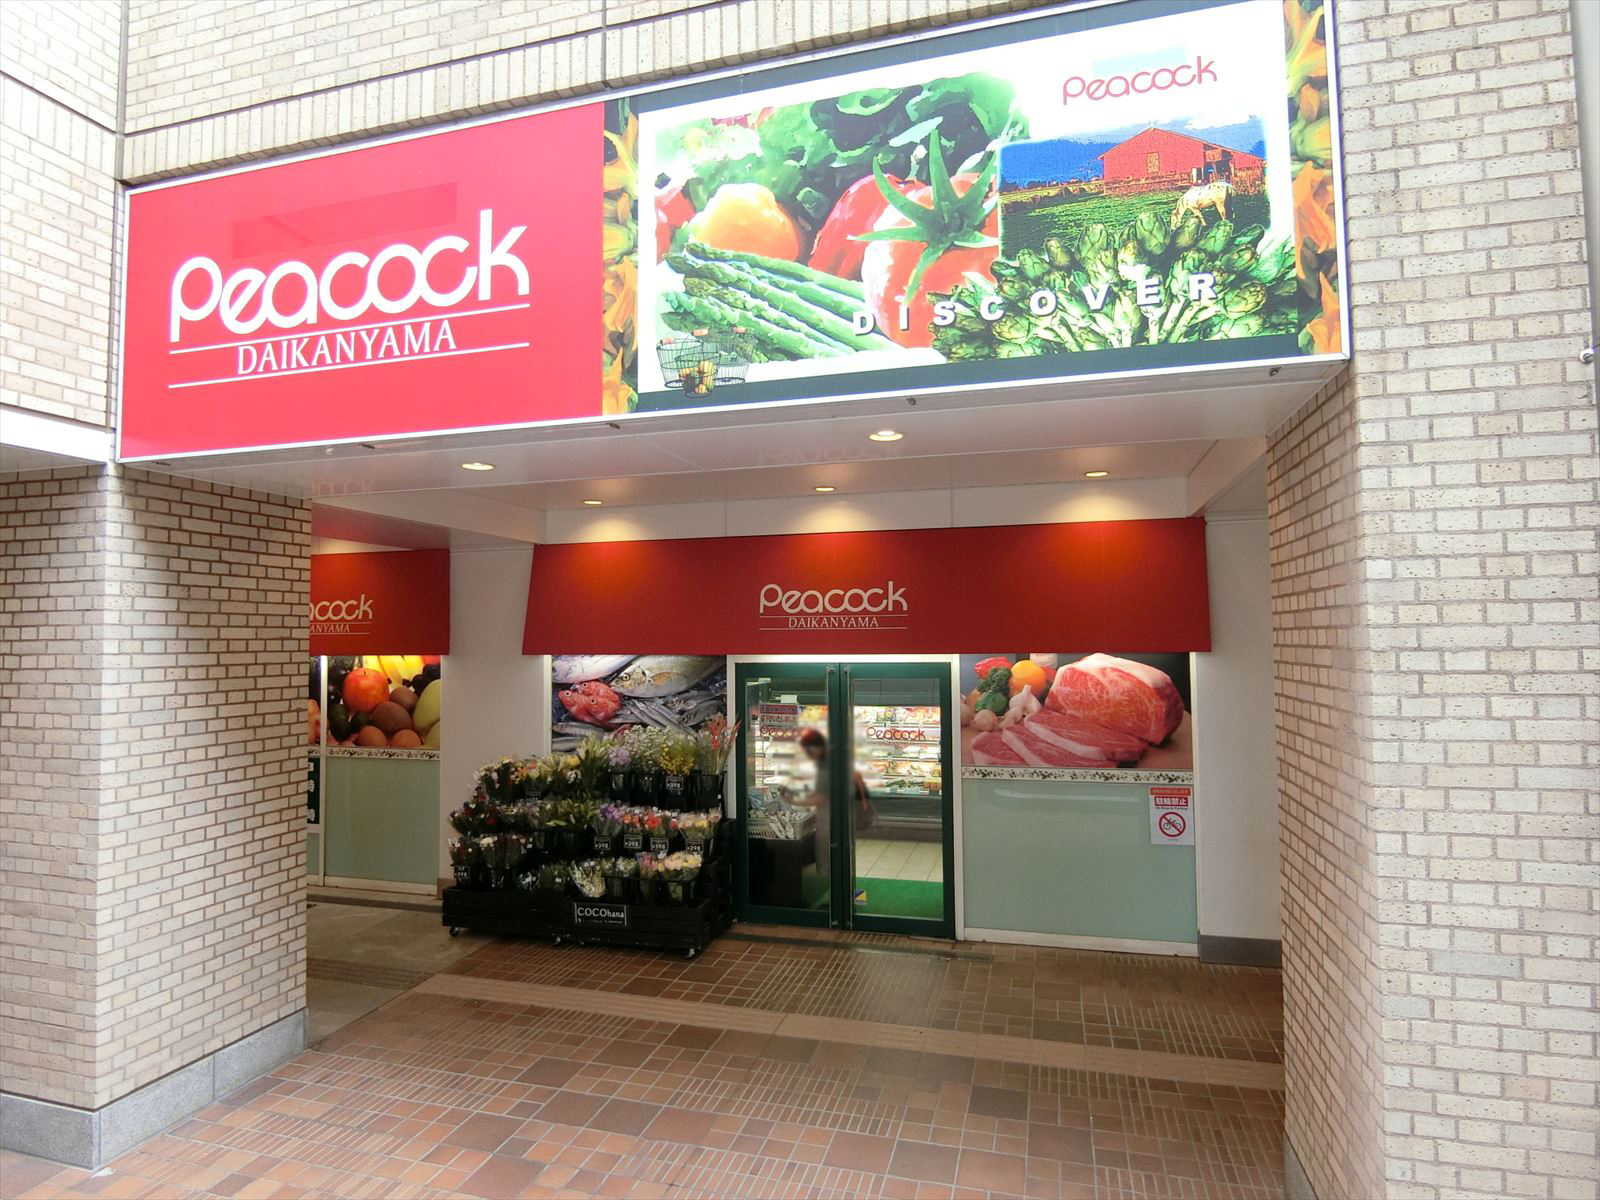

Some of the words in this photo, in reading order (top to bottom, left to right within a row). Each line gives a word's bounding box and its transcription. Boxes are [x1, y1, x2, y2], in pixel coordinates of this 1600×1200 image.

[1062, 56, 1218, 105] Peacock
[169, 208, 531, 343] Peacock
[852, 272, 1218, 337] DISCOVER
[236, 318, 457, 376] DAIKANYAMA
[759, 580, 908, 614] Peacock
[788, 616, 879, 628] DAIKANYAMA
[577, 907, 625, 918] COCOhana
